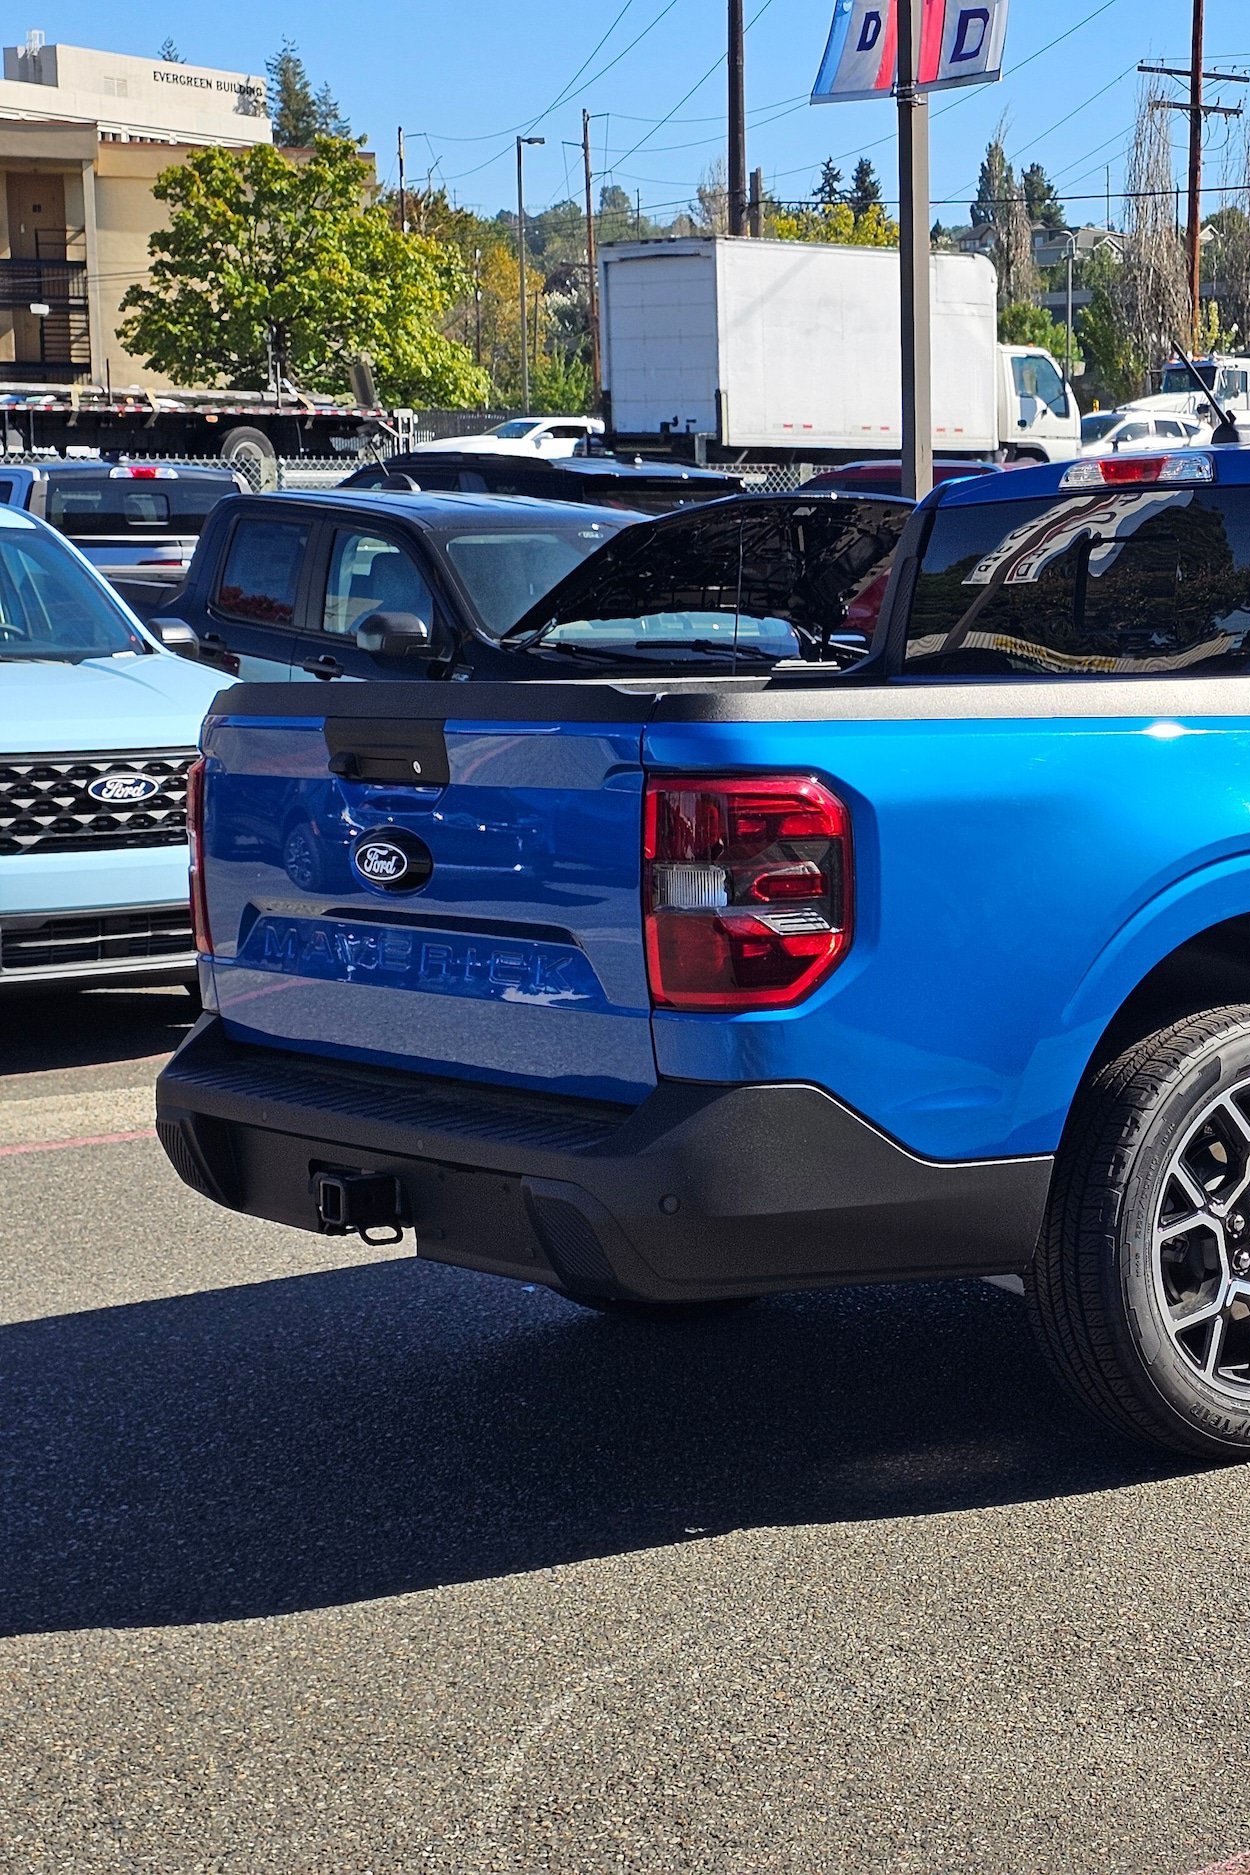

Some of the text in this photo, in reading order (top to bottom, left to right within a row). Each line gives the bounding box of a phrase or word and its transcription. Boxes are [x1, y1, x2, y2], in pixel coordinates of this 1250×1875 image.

[153, 71, 263, 97] EVERGREEN BUILDING
[101, 778, 146, 799] Ford
[364, 848, 399, 875] Ford
[264, 924, 578, 994] MAVERICK
